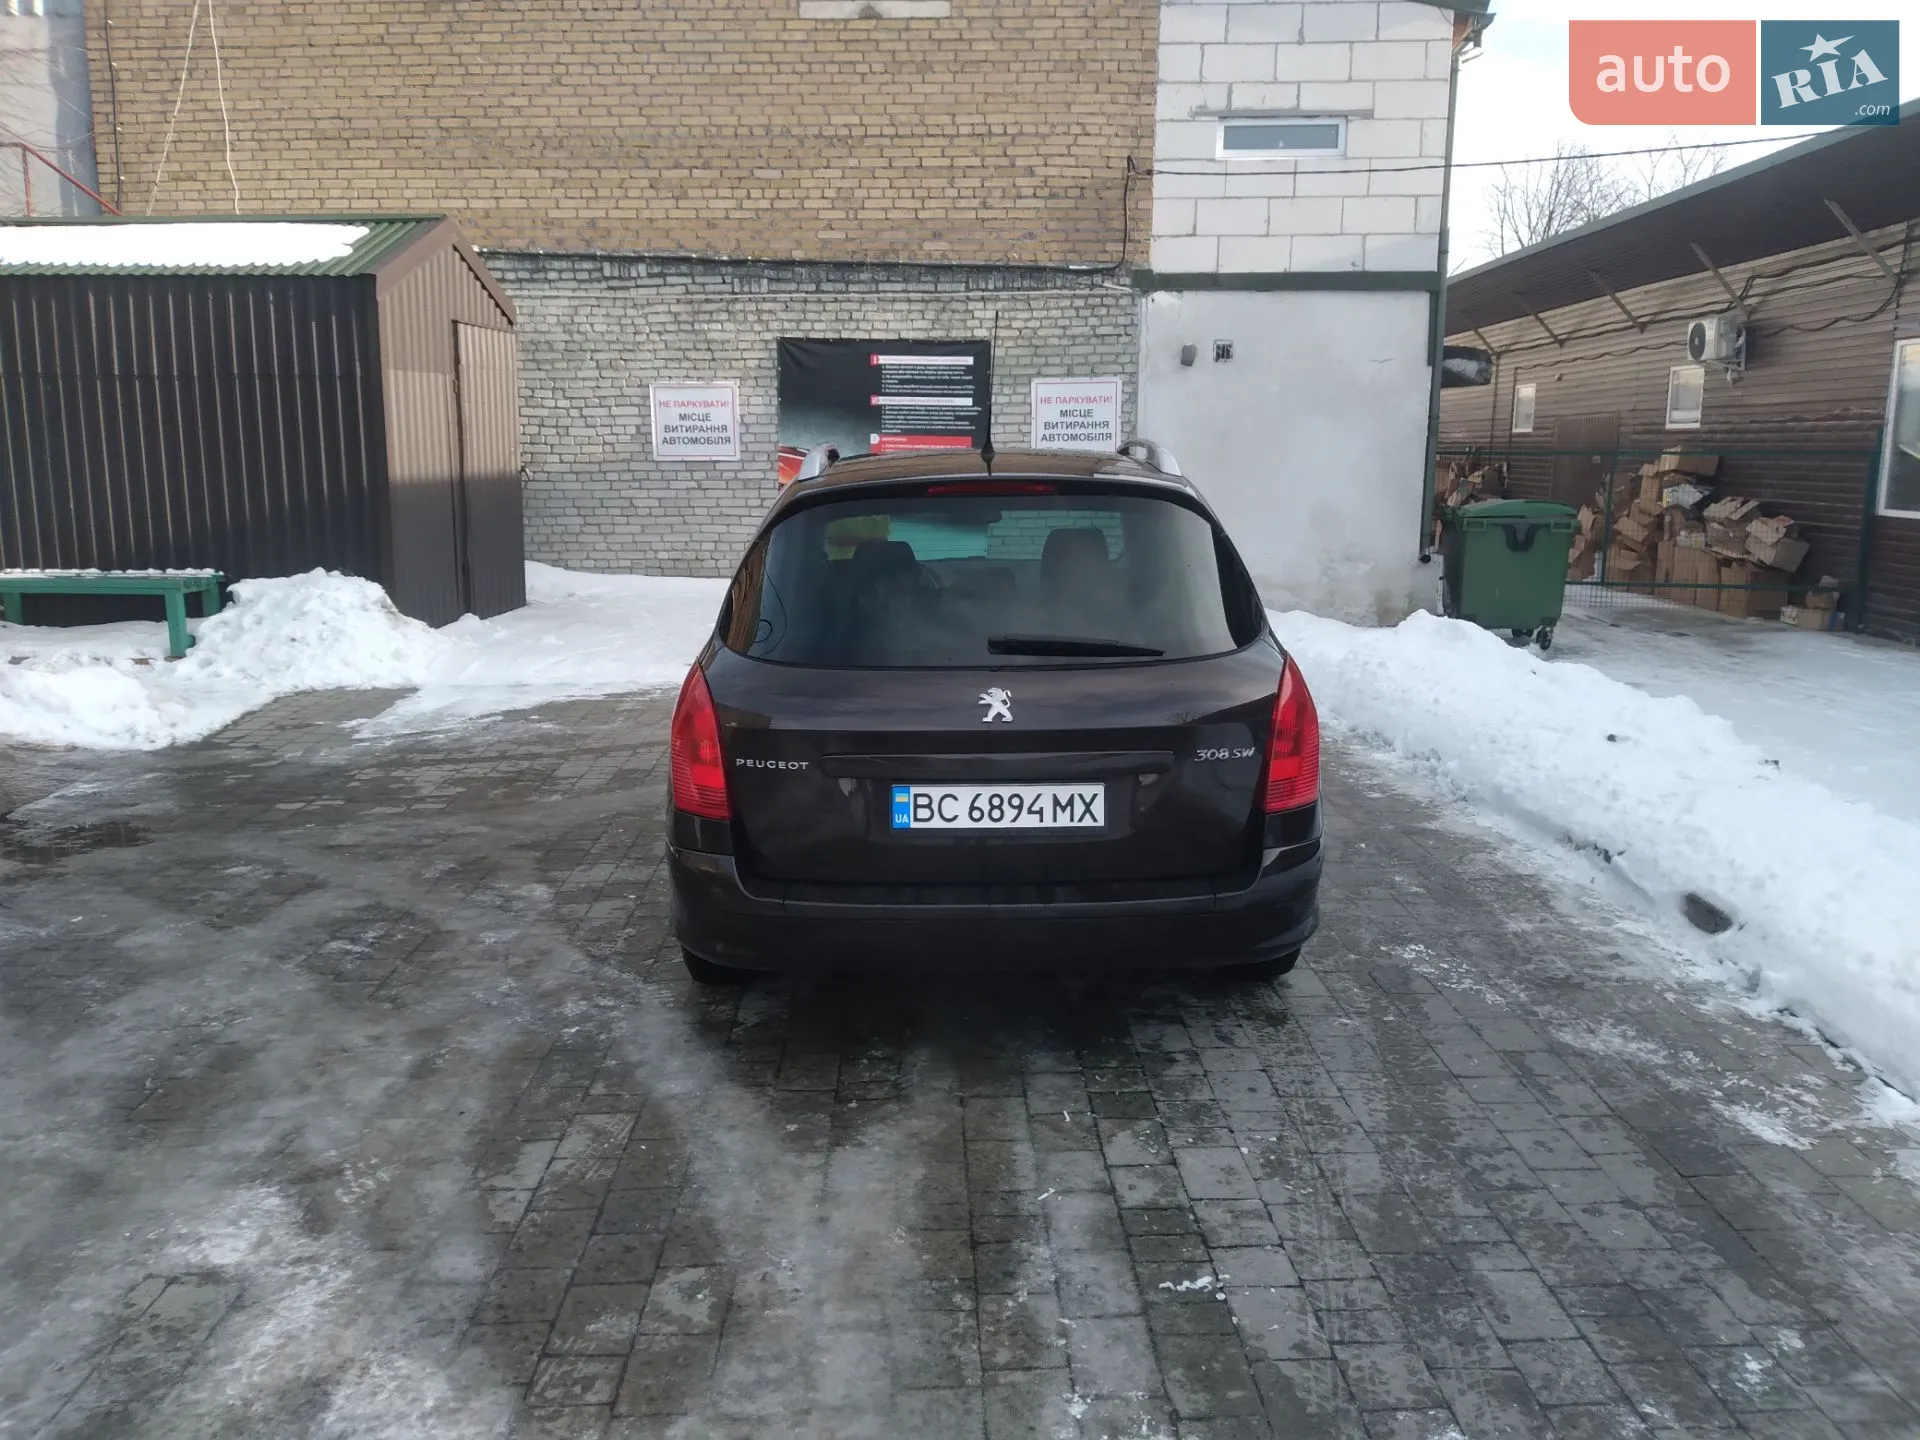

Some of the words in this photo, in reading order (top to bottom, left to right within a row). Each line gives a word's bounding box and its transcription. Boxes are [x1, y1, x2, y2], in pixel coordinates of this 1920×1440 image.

[659, 400, 671, 408] НЕ
[674, 400, 730, 408] ПАРКУВАТИ!
[1040, 396, 1053, 405] НЕ
[1055, 395, 1113, 405] ПАРКУВАТИ!
[678, 412, 712, 423] МІСЦЕ
[1059, 409, 1094, 419] МІСЦЕ
[664, 424, 728, 434] ВИТИРАННЯ
[1043, 420, 1110, 430] ВИТИРАННЯ
[661, 436, 732, 445] АВТОМОБІЛЯ
[1040, 432, 1113, 442] АВТОМОБІЛЯ
[1193, 747, 1229, 762] 308
[1231, 746, 1256, 759] SW
[735, 758, 810, 770] PEUGEOT
[912, 792, 960, 823] BC
[967, 792, 1044, 823] 6894
[1052, 792, 1100, 823] MX
[895, 813, 909, 823] UA
